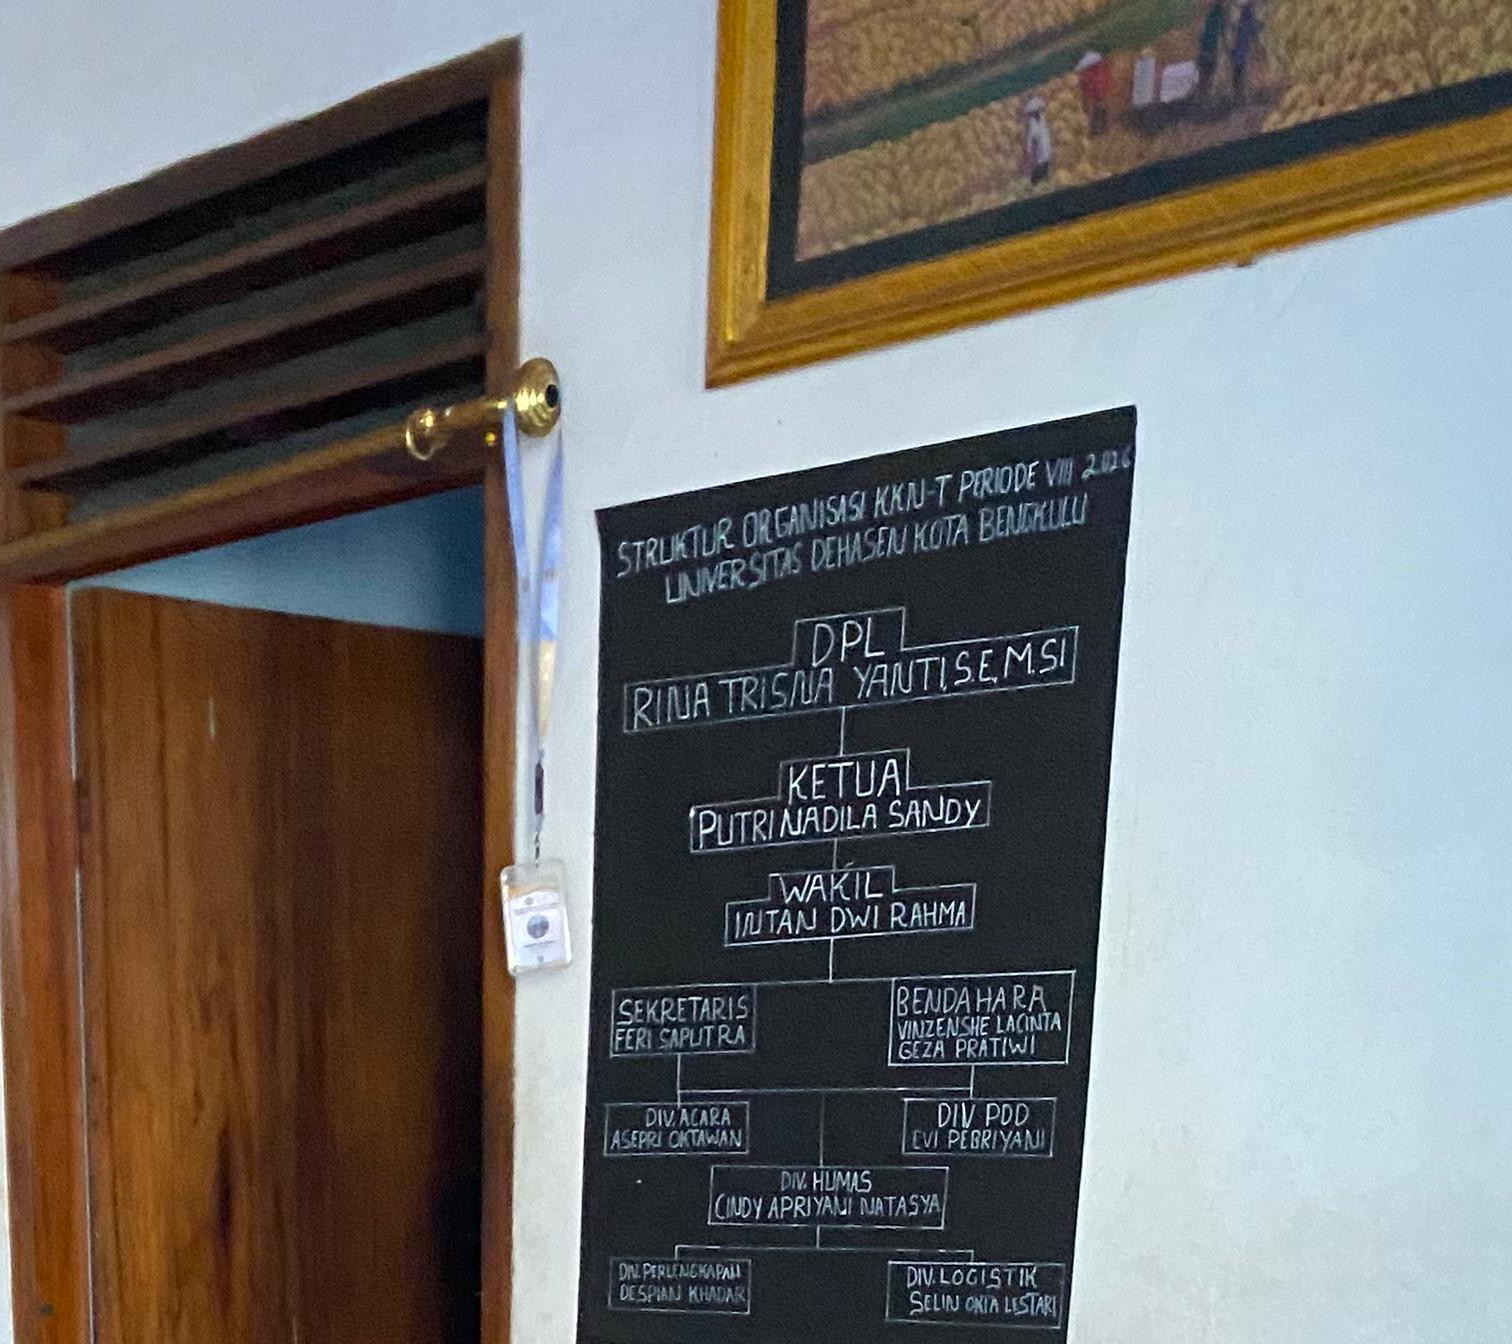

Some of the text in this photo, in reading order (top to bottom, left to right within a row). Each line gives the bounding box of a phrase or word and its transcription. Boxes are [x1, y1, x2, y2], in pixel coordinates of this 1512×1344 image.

[617, 517, 735, 578] STRUKTUR
[743, 490, 866, 548] ORGANISASI
[874, 474, 952, 518] KKN-T
[959, 460, 1039, 503] PERIODE
[665, 493, 1088, 604] UNIVERSITAS DEHASEN KOTA BENGKULU
[812, 616, 885, 667] DPL
[633, 683, 710, 730] RINA
[718, 667, 833, 714] TRISNA
[788, 758, 900, 805] KETUA
[698, 794, 981, 849] PUTRI NADILA SANDY
[779, 865, 884, 904] WAKIL
[735, 901, 966, 940] INTAN DWI RAHMA
[616, 995, 749, 1026] SEKRETARIS
[896, 984, 1047, 1017] BENDAHARA
[615, 1024, 745, 1051] FERI SAPUTRA
[897, 1015, 991, 1040] VINZENSHE
[898, 1034, 1035, 1060] GEZA PRATIWI
[679, 1107, 731, 1127] ACARA
[938, 1101, 1029, 1128] DIV PDD
[813, 1169, 873, 1192] HUMAS
[715, 1193, 940, 1220] CINDY APRIYANI NATASYA
[940, 1265, 1038, 1289] LOGISTIK
[909, 1290, 960, 1315] SELIN
